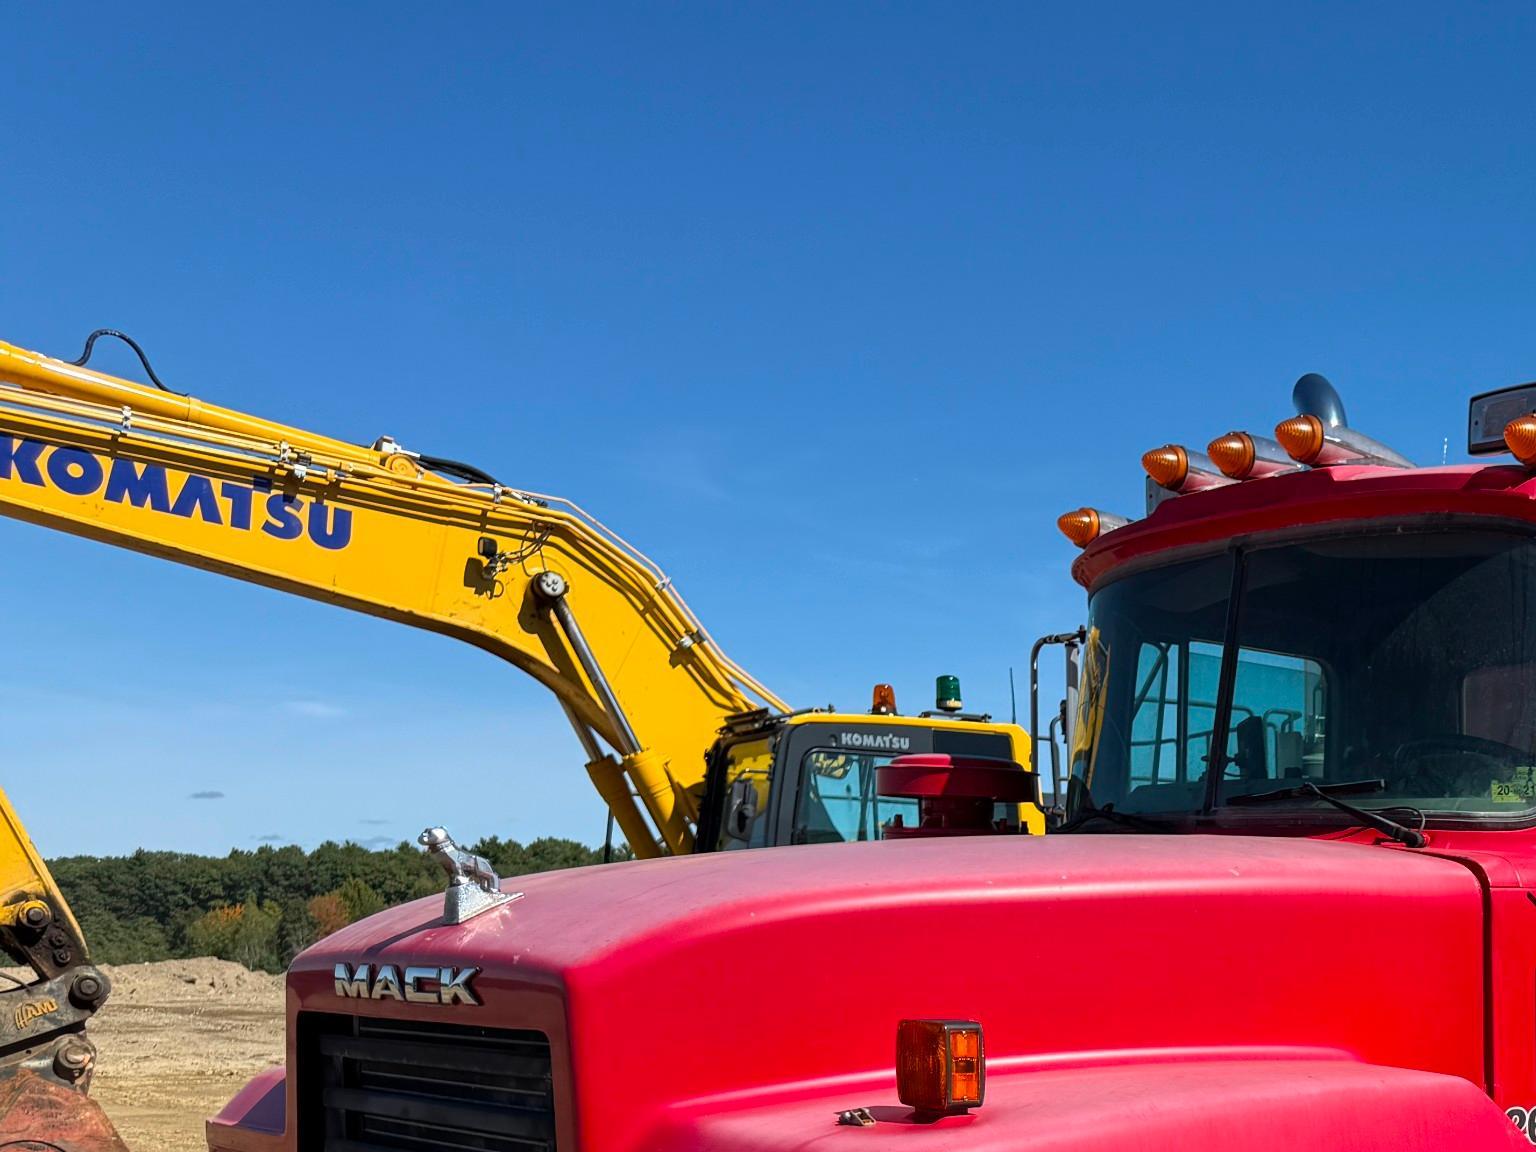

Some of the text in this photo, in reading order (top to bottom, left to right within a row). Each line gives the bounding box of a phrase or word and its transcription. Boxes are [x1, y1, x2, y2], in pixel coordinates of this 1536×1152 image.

[0, 434, 352, 550] KOMATSU
[841, 732, 910, 750] KOMATSU
[334, 962, 484, 1006] MACK
